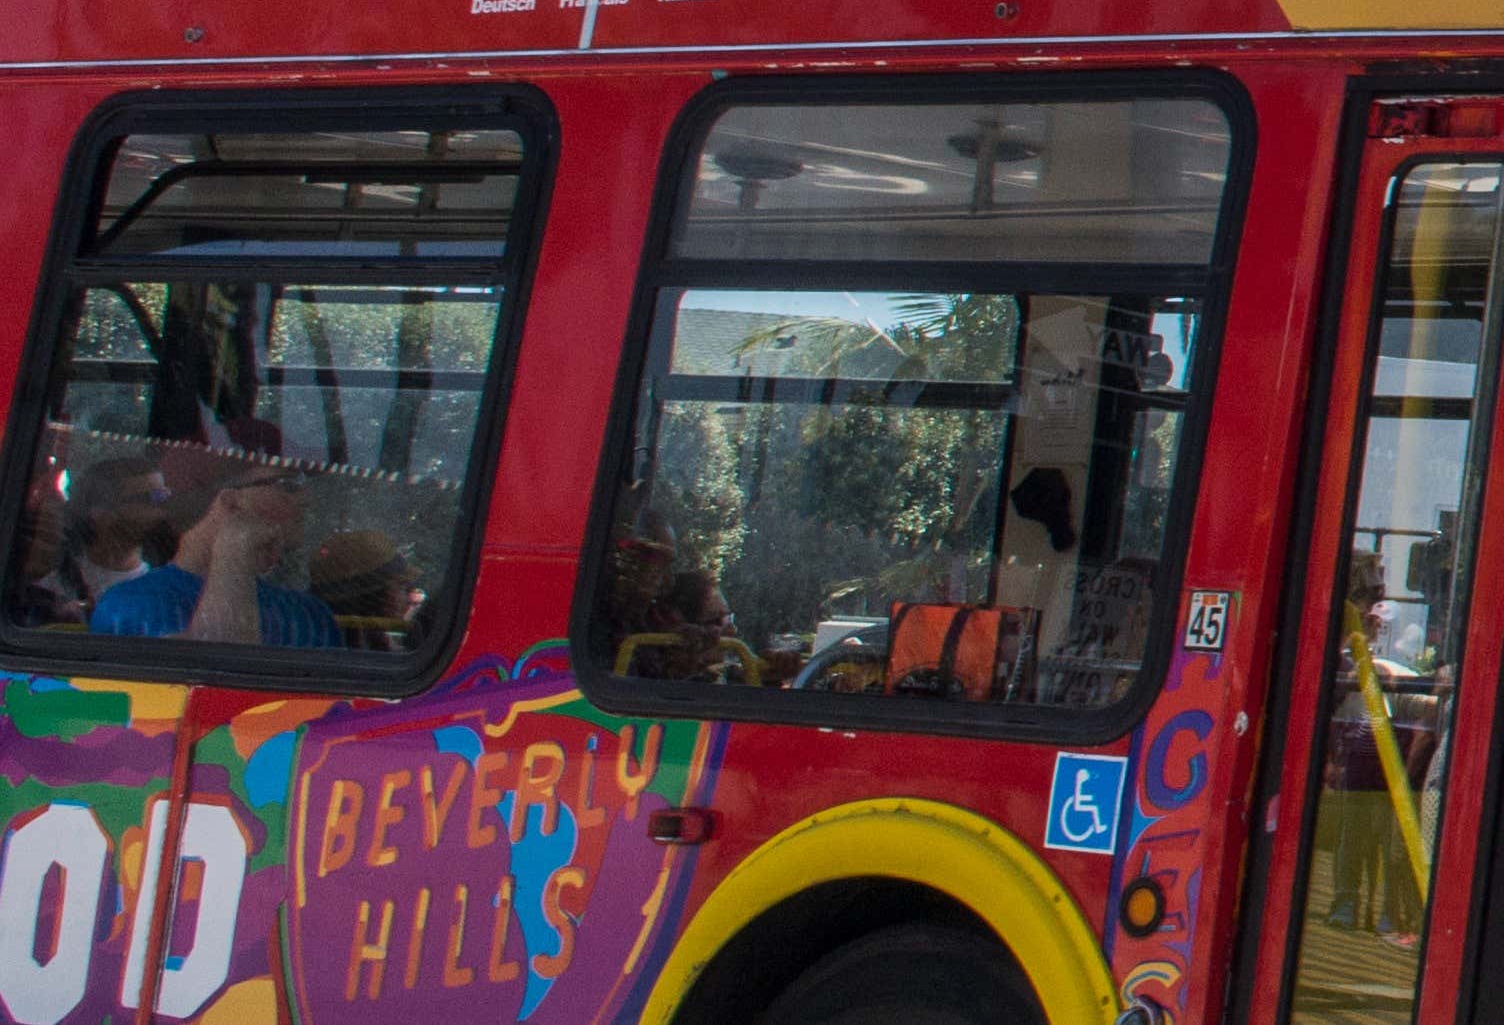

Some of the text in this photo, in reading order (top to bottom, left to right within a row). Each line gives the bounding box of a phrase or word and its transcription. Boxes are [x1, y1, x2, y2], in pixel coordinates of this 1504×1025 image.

[1188, 606, 1223, 645] 45
[317, 723, 664, 879] BEVERLY
[344, 866, 590, 1003] HILLS
